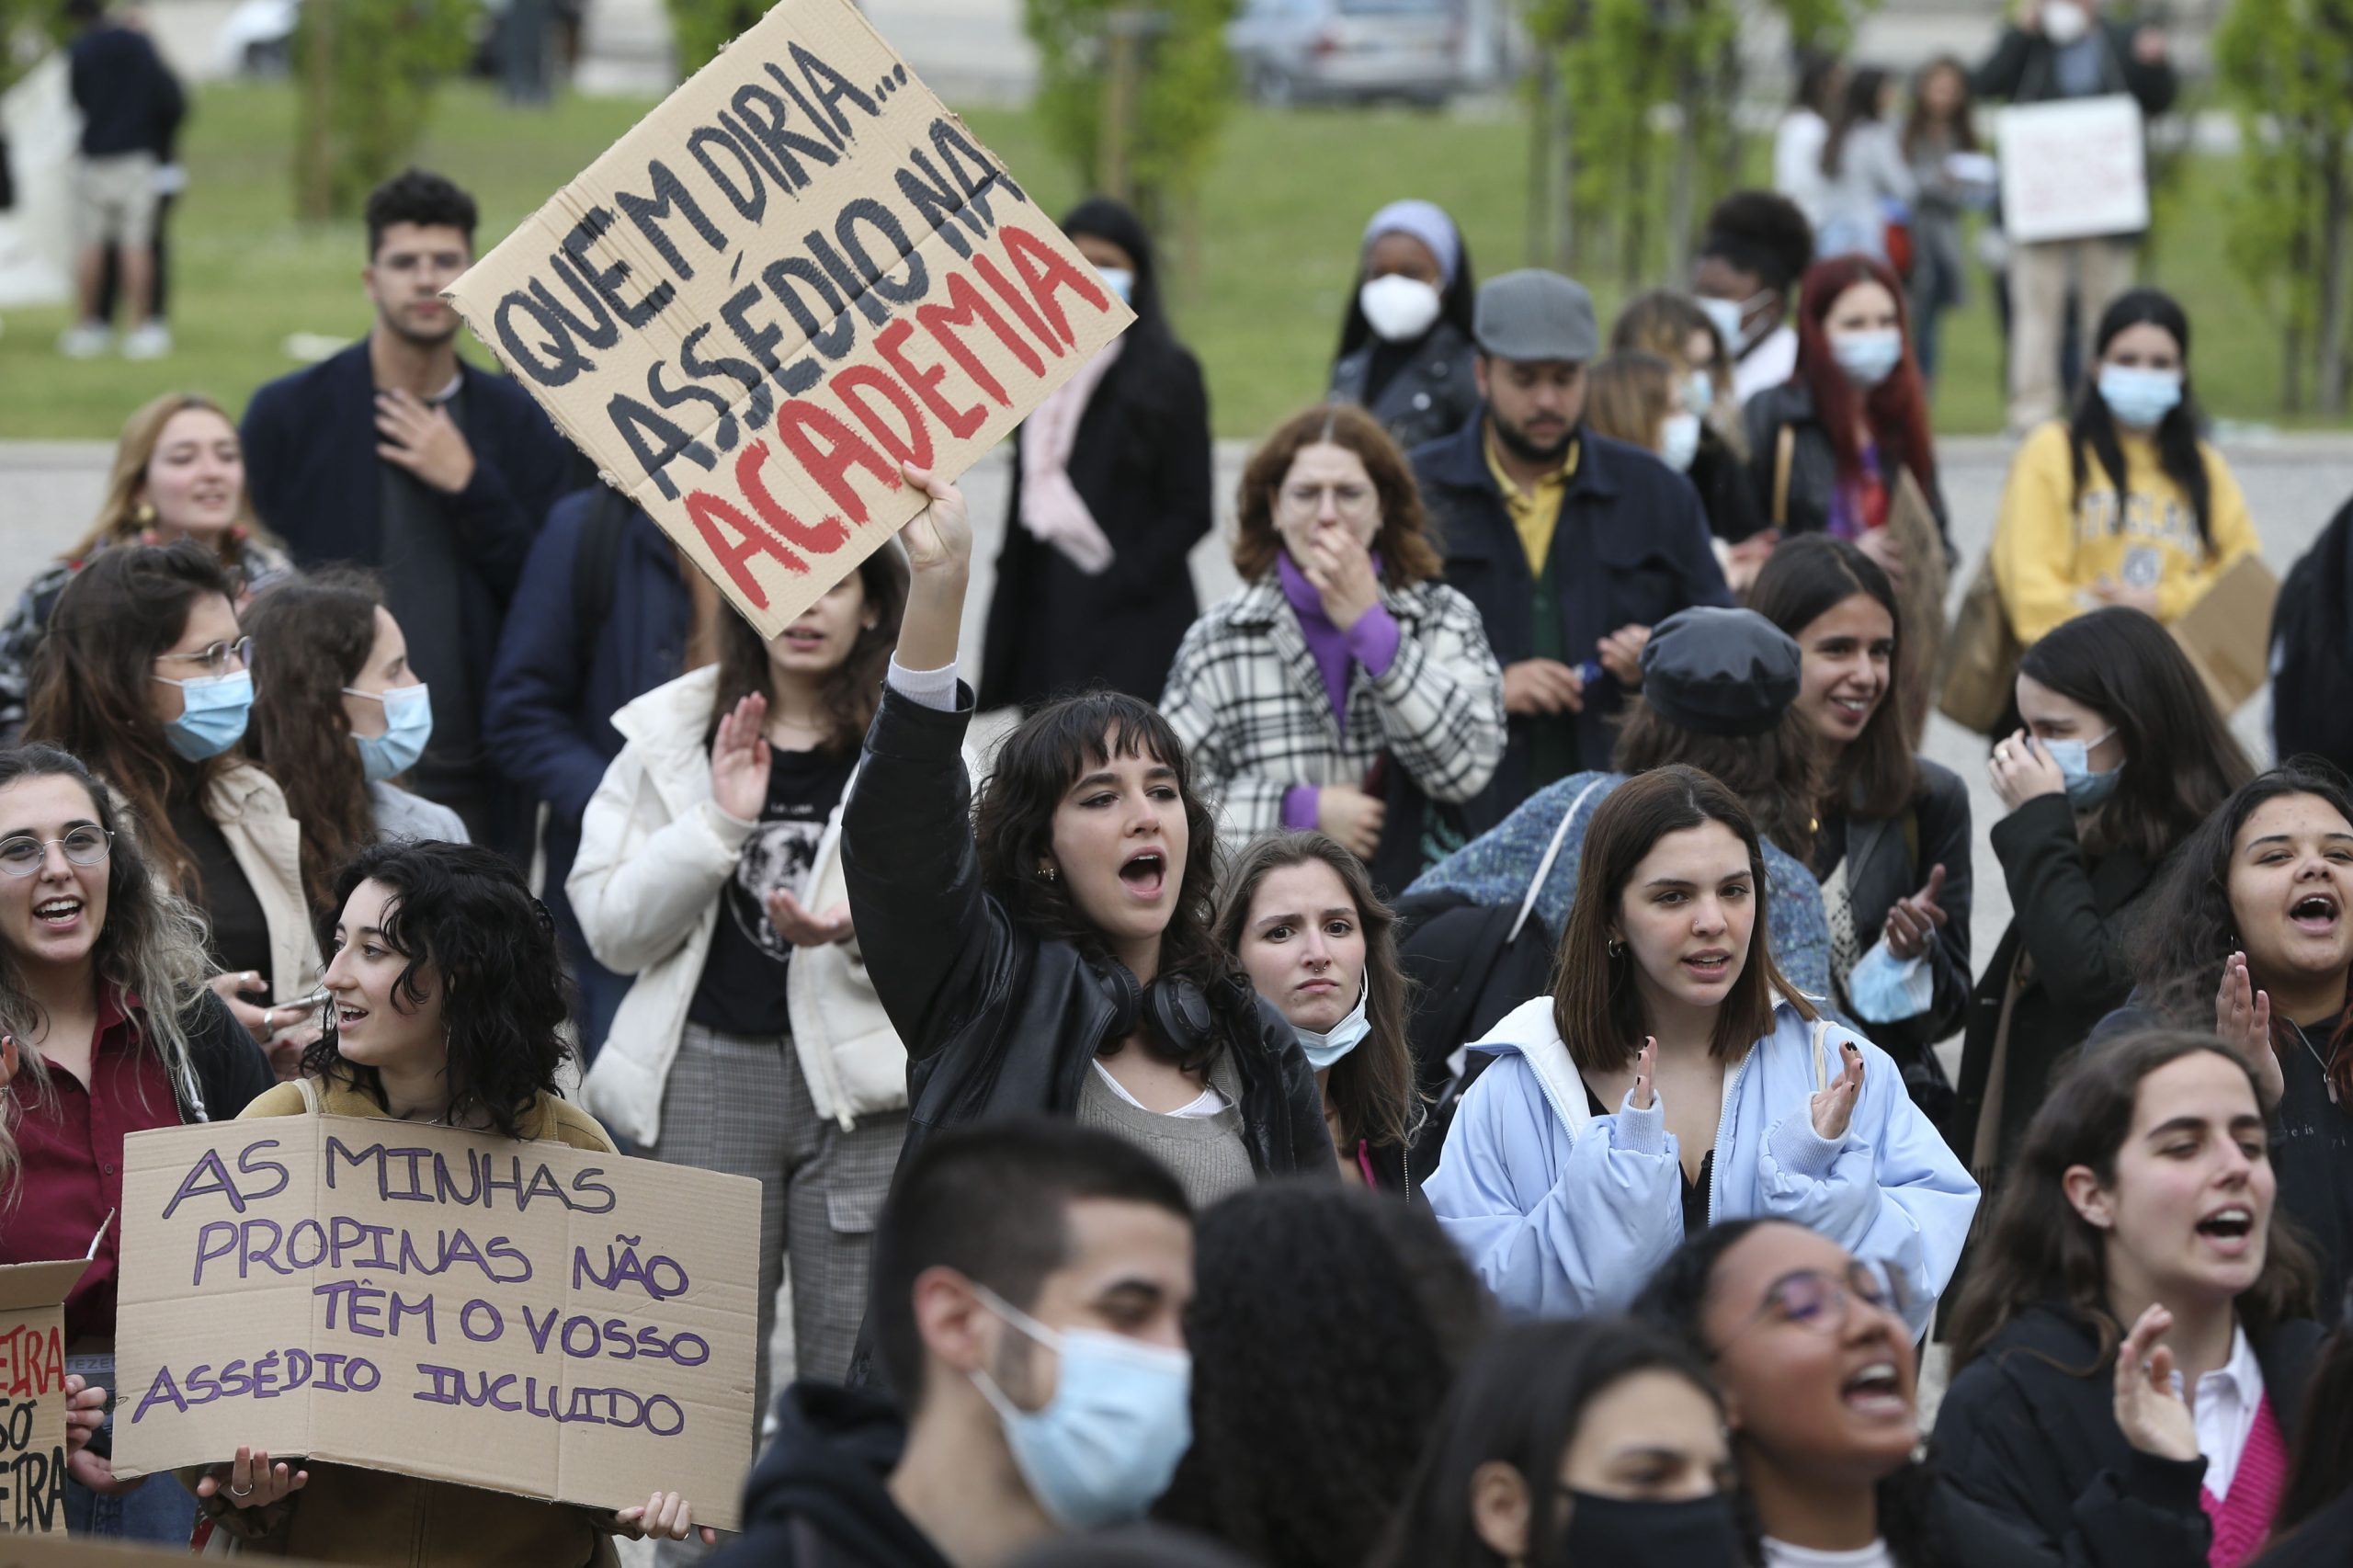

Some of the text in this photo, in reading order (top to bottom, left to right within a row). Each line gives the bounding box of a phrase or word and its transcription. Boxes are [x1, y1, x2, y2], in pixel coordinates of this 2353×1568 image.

[494, 40, 909, 387] QUEM DIRIA...
[606, 118, 1026, 501] ASSÉDIO NA
[684, 225, 1109, 610] ACADEMIA
[162, 1136, 617, 1219] AS MINHAS
[192, 1216, 689, 1301] PROPINAS NÃO
[313, 1278, 710, 1367] TÊM O VOSSO
[131, 1347, 685, 1436] ASSÉDIO INCLUIDO
